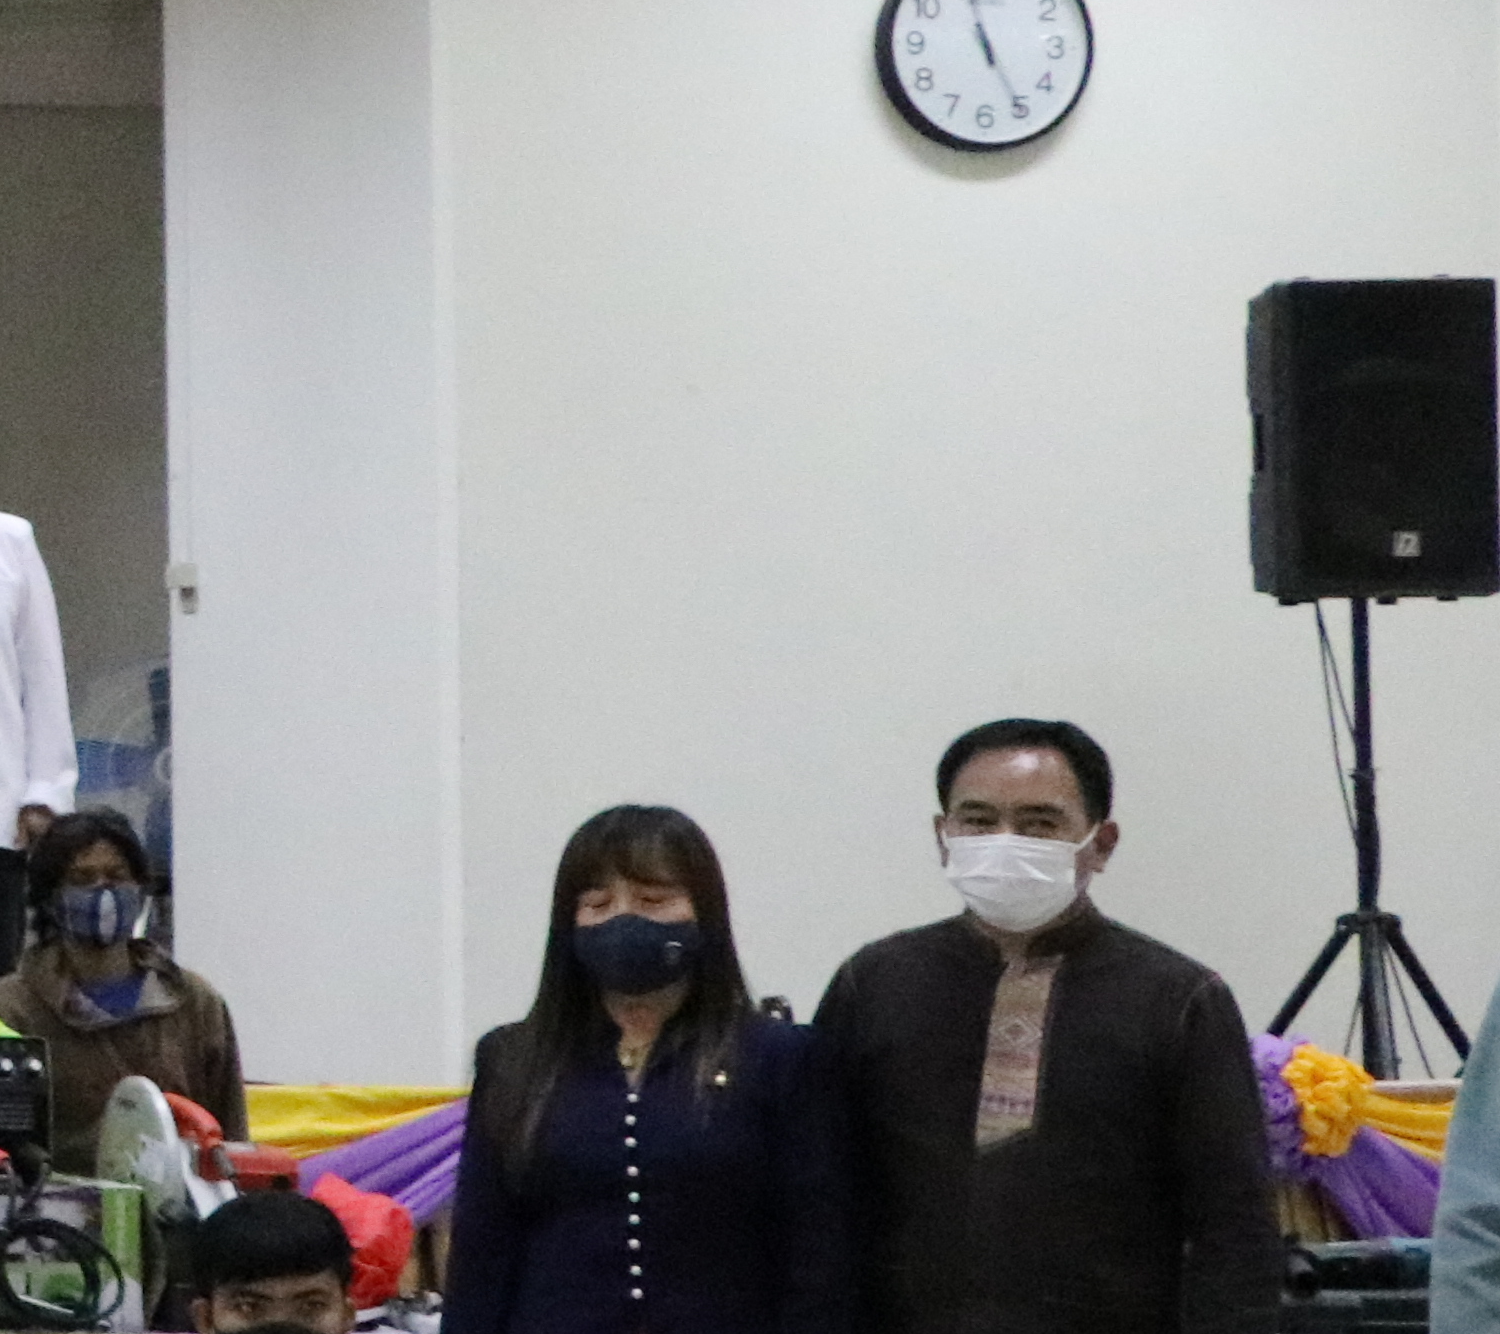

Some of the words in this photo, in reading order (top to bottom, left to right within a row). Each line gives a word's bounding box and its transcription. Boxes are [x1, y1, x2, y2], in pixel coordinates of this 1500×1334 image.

[907, 30, 925, 55] 9
[1047, 35, 1065, 59] 3
[915, 67, 933, 92] 8
[1036, 71, 1054, 92] 4
[943, 94, 961, 114] 7
[1012, 96, 1030, 119] 5
[976, 105, 995, 128] 6
